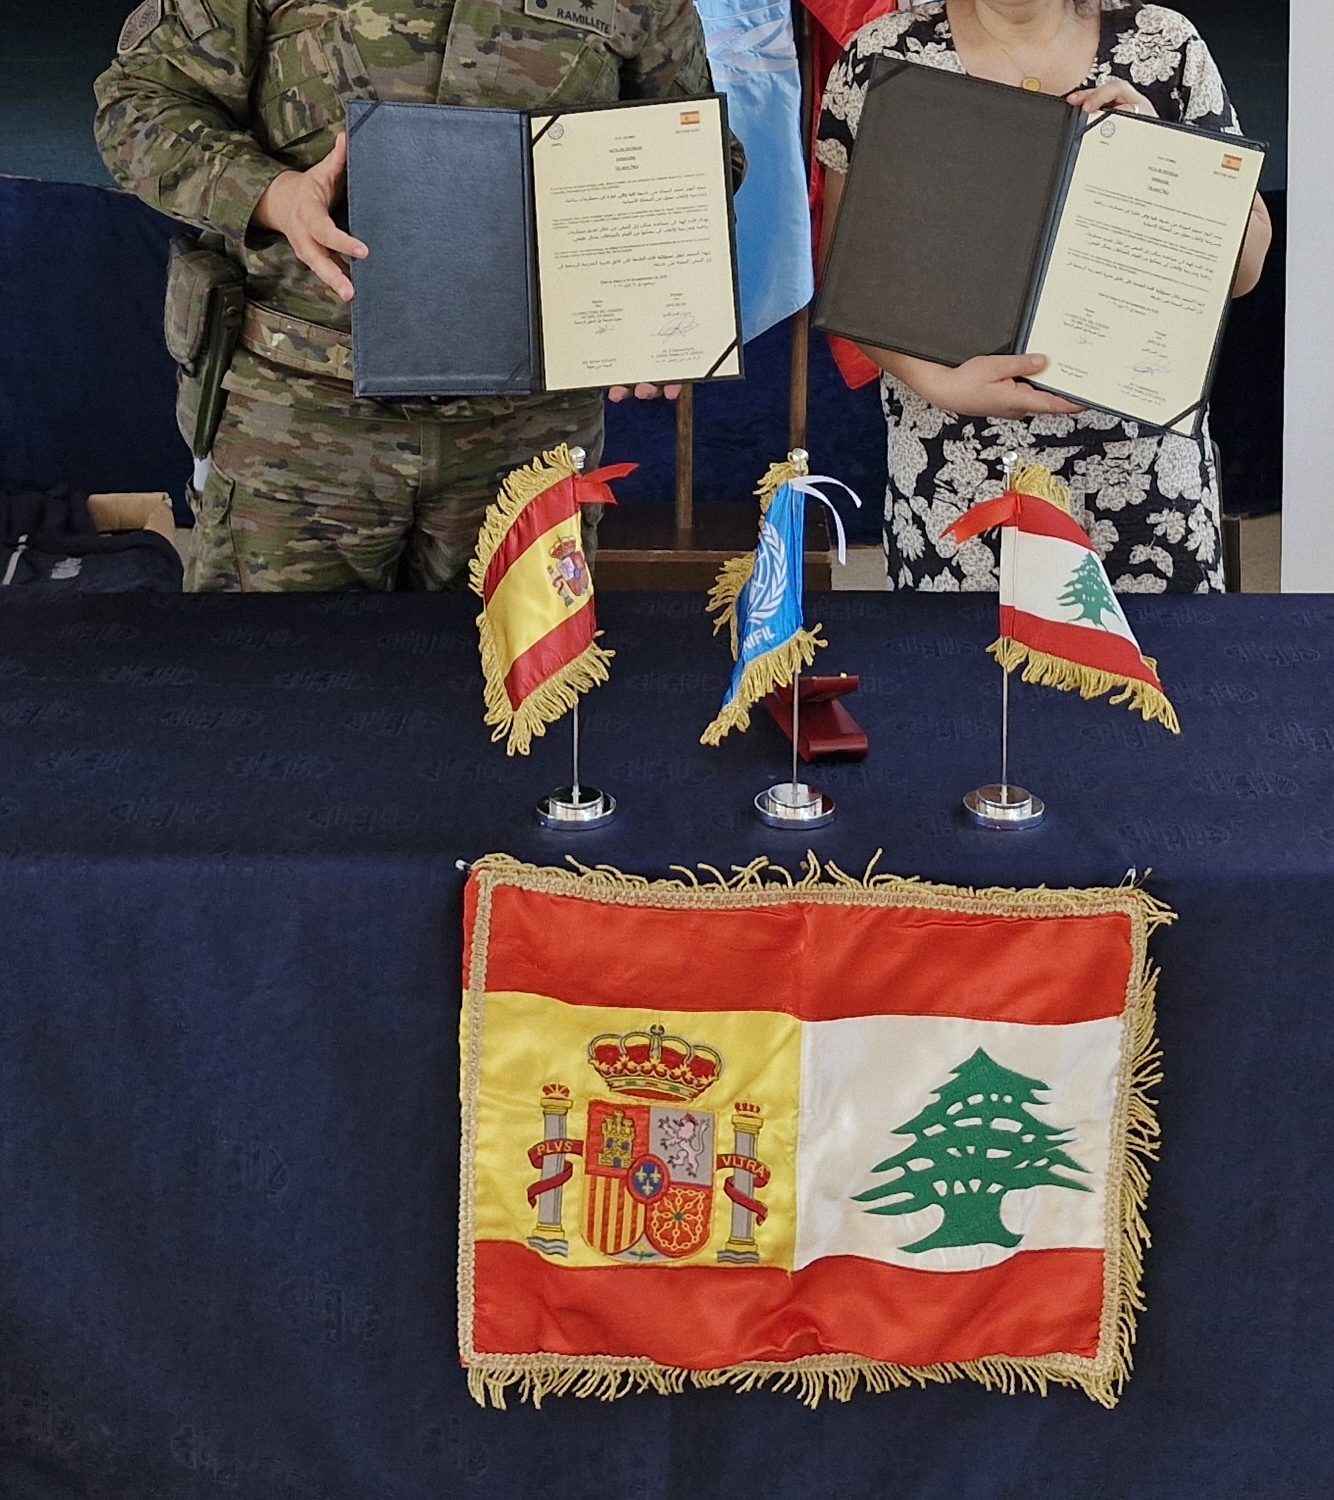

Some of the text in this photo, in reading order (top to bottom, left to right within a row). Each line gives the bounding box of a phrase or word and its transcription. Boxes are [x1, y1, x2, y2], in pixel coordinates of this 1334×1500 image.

[556, 7, 610, 34] RAMILLETE
[743, 625, 776, 652] NIFIL
[536, 1141, 765, 1178] PLVS VLTRA
